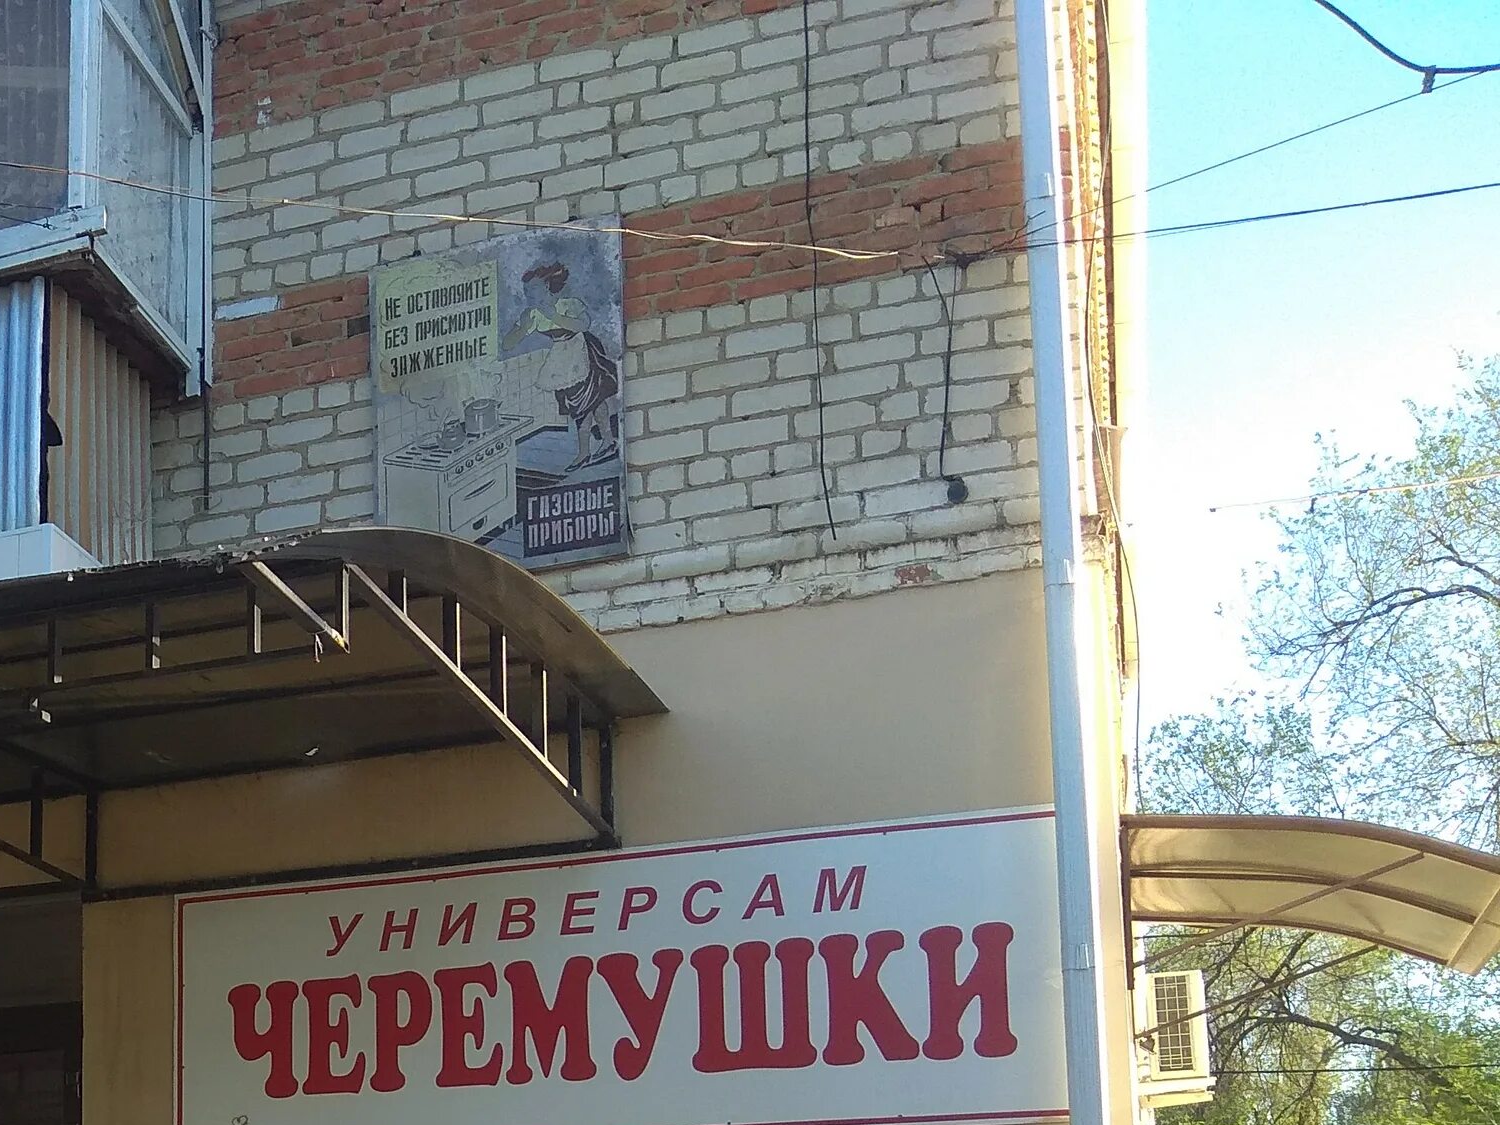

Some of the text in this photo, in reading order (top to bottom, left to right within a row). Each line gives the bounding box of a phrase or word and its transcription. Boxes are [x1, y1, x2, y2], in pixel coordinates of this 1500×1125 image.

[384, 305, 491, 350] БЕЗ ПРИСМОТРА
[385, 297, 402, 320] НЕ
[390, 335, 488, 378] ЗАЖЖЕННЫЕ
[527, 484, 614, 520] ГАЗОВЫЕ
[528, 511, 615, 548] ПРИБОРЫ
[326, 864, 868, 957] УНИВЕРСАМ
[228, 921, 1018, 1098] ЧЕРЕМУШКИ
